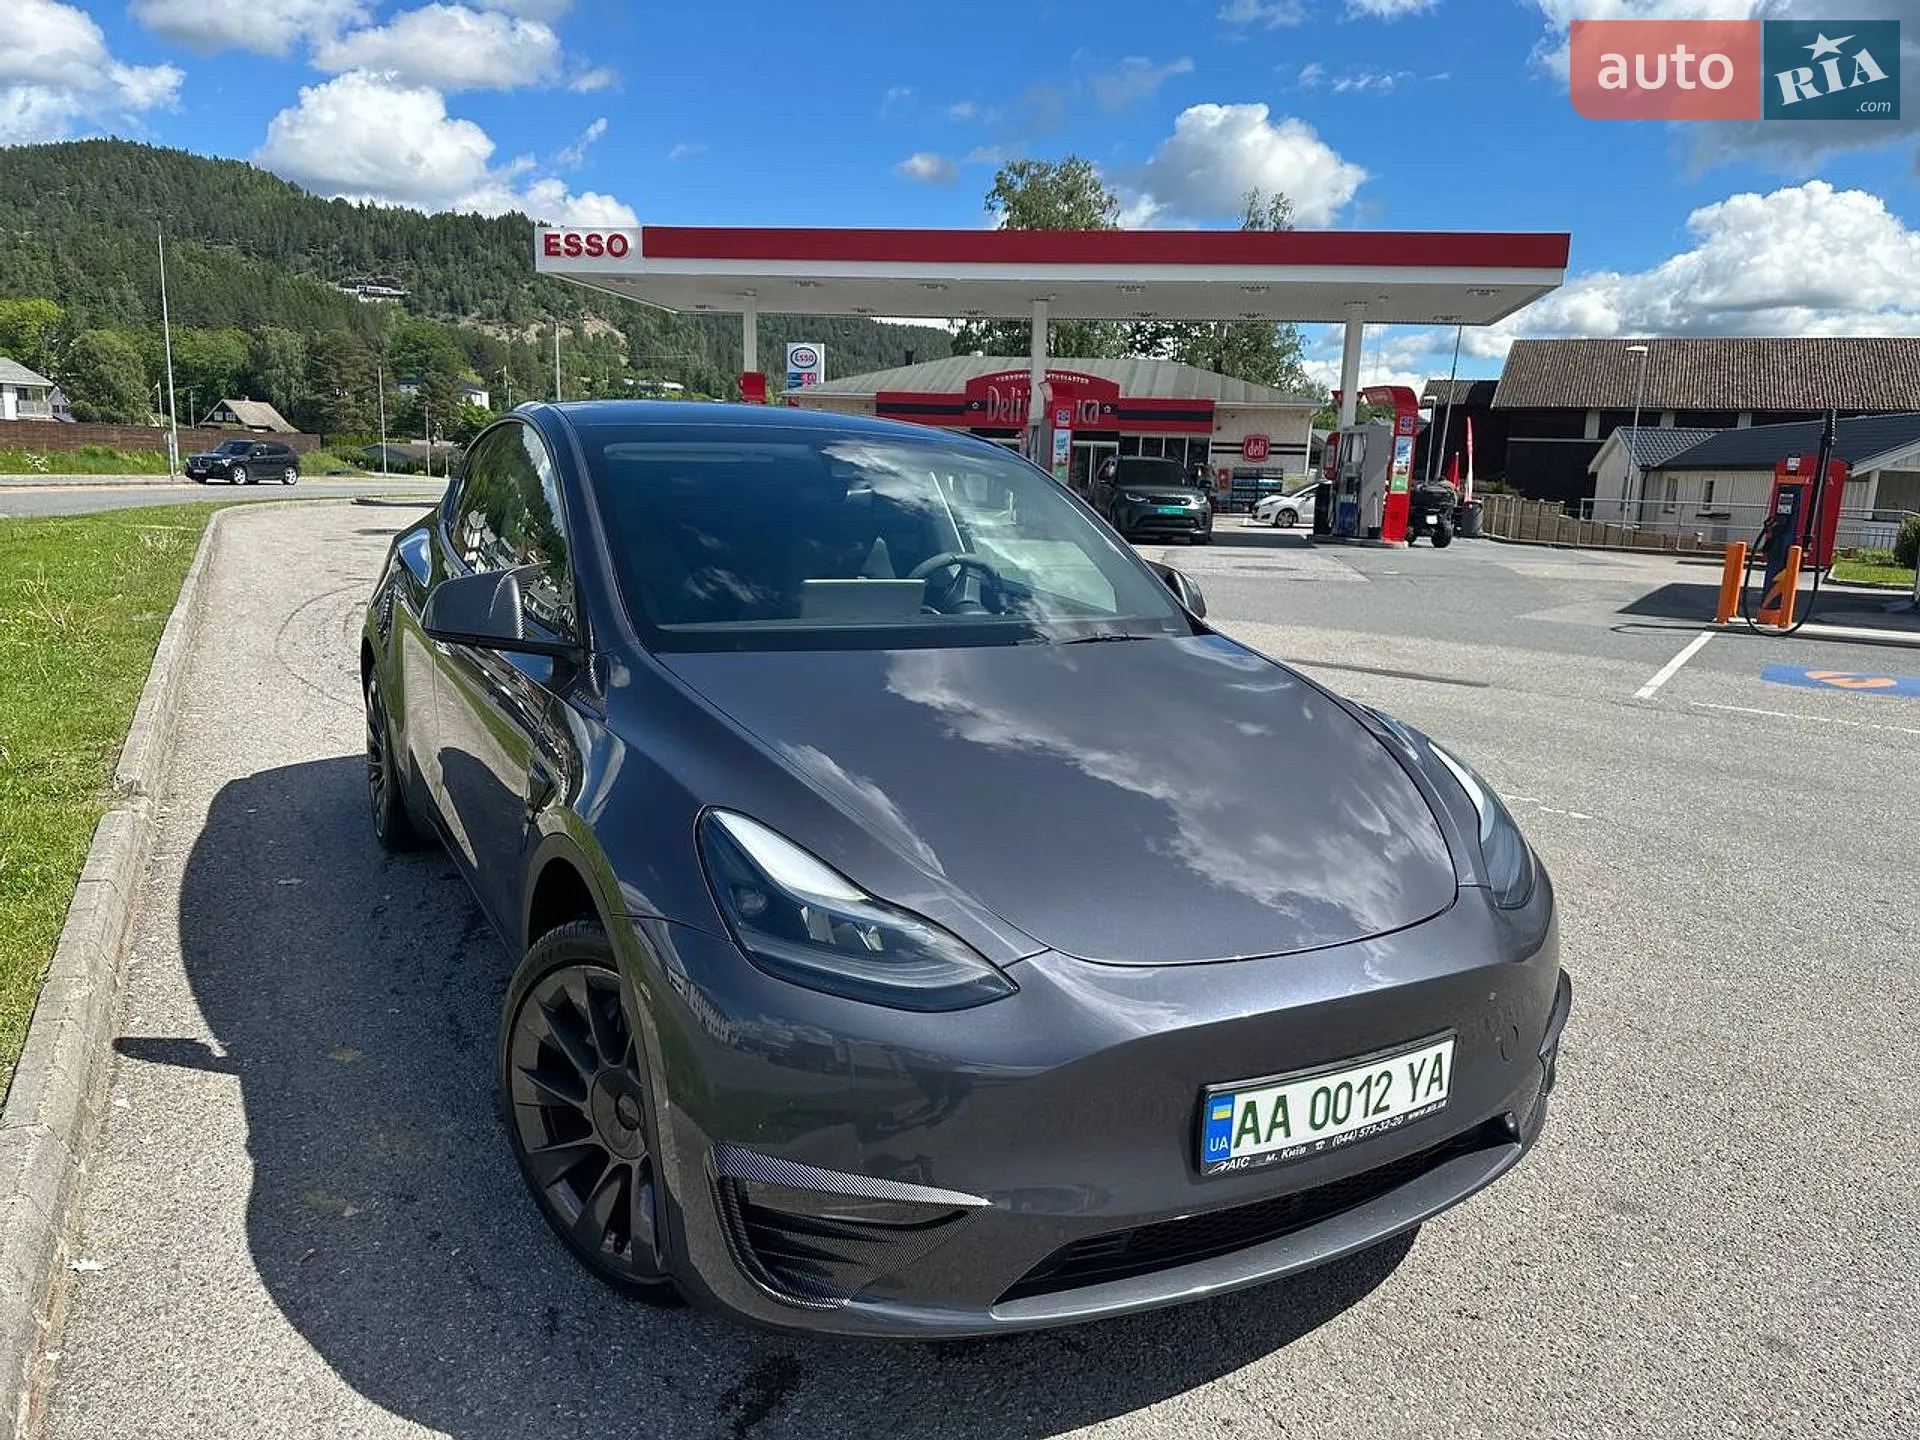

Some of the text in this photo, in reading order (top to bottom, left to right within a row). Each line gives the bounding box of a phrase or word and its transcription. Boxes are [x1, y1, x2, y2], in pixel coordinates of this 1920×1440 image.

[544, 233, 628, 257] ESSO
[986, 386, 1021, 422] Deli
[1248, 440, 1264, 456] deli
[1233, 1052, 1443, 1148] AA 0012 YA
[1210, 1136, 1229, 1151] UA
